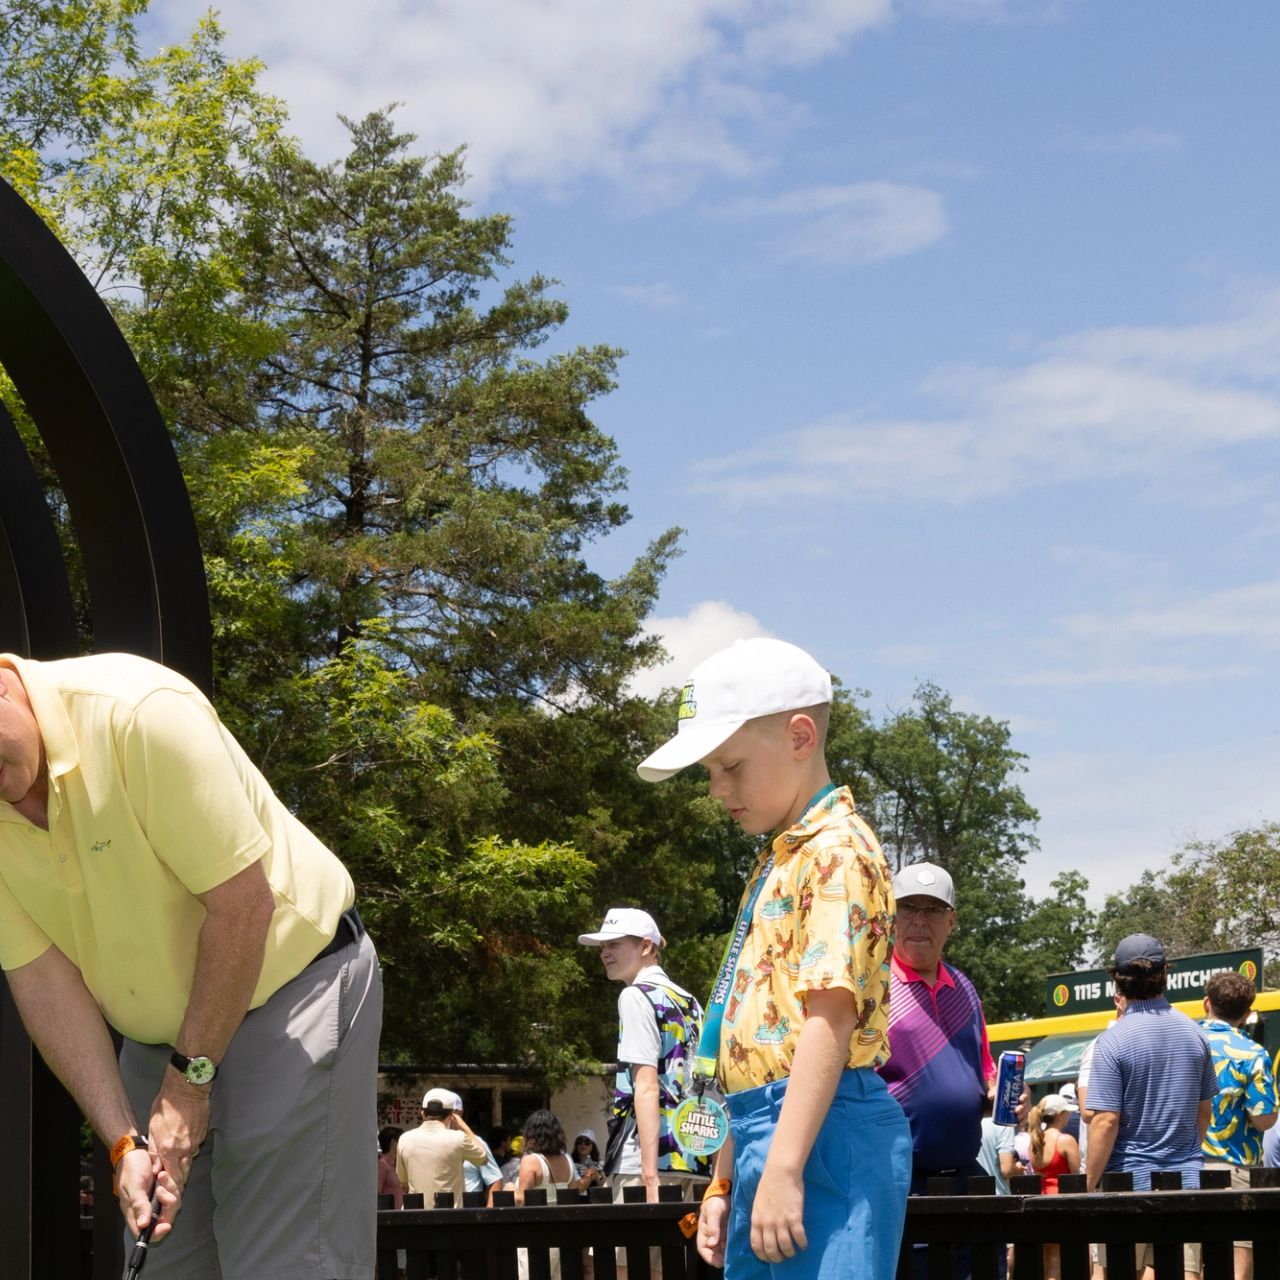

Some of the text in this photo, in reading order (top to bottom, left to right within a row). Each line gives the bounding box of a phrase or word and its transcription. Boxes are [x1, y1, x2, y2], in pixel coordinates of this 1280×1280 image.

[730, 920, 748, 955] LITTLE
[714, 956, 736, 1005] SHARKS
[1074, 982, 1101, 1001] 1115
[1166, 966, 1233, 990] KITCH
[1009, 1074, 1022, 1113] ULTRA
[680, 1121, 719, 1139] SHARKS
[687, 1111, 716, 1127] LITTLE
